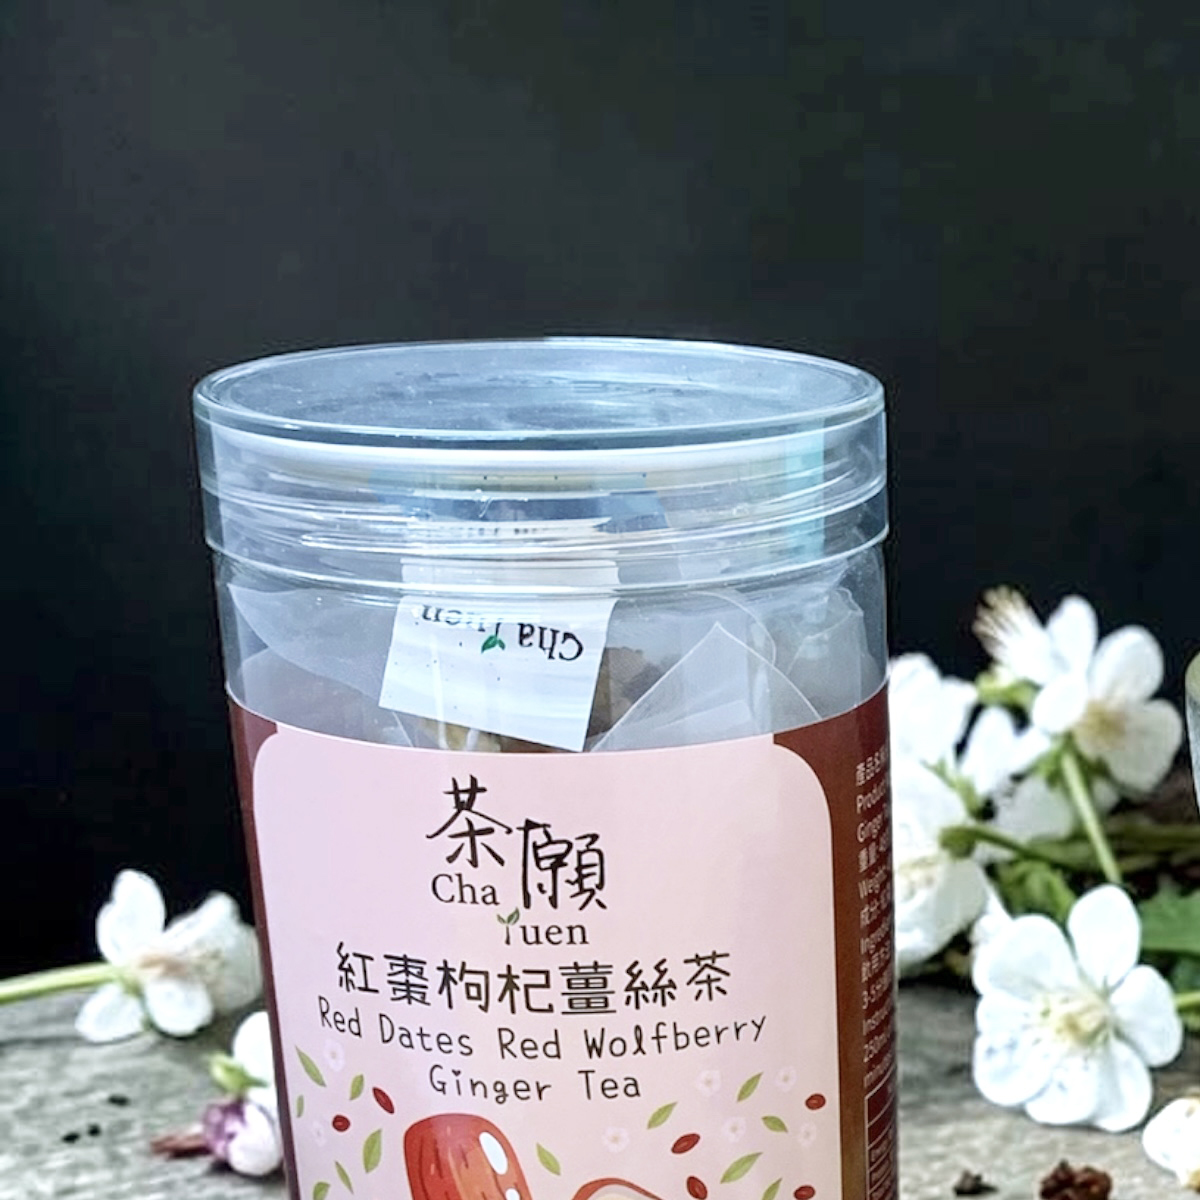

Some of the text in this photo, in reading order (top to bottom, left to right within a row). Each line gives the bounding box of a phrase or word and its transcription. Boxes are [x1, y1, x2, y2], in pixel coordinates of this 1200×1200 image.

[517, 622, 585, 662] Cha
[431, 872, 500, 906] Cha
[496, 907, 589, 946] Yuen
[336, 941, 731, 1016] 紅棗枸杞薑絲茶
[318, 995, 767, 1060] Red Dates Red Wolfberry
[429, 1064, 641, 1105] Ginger Tea
